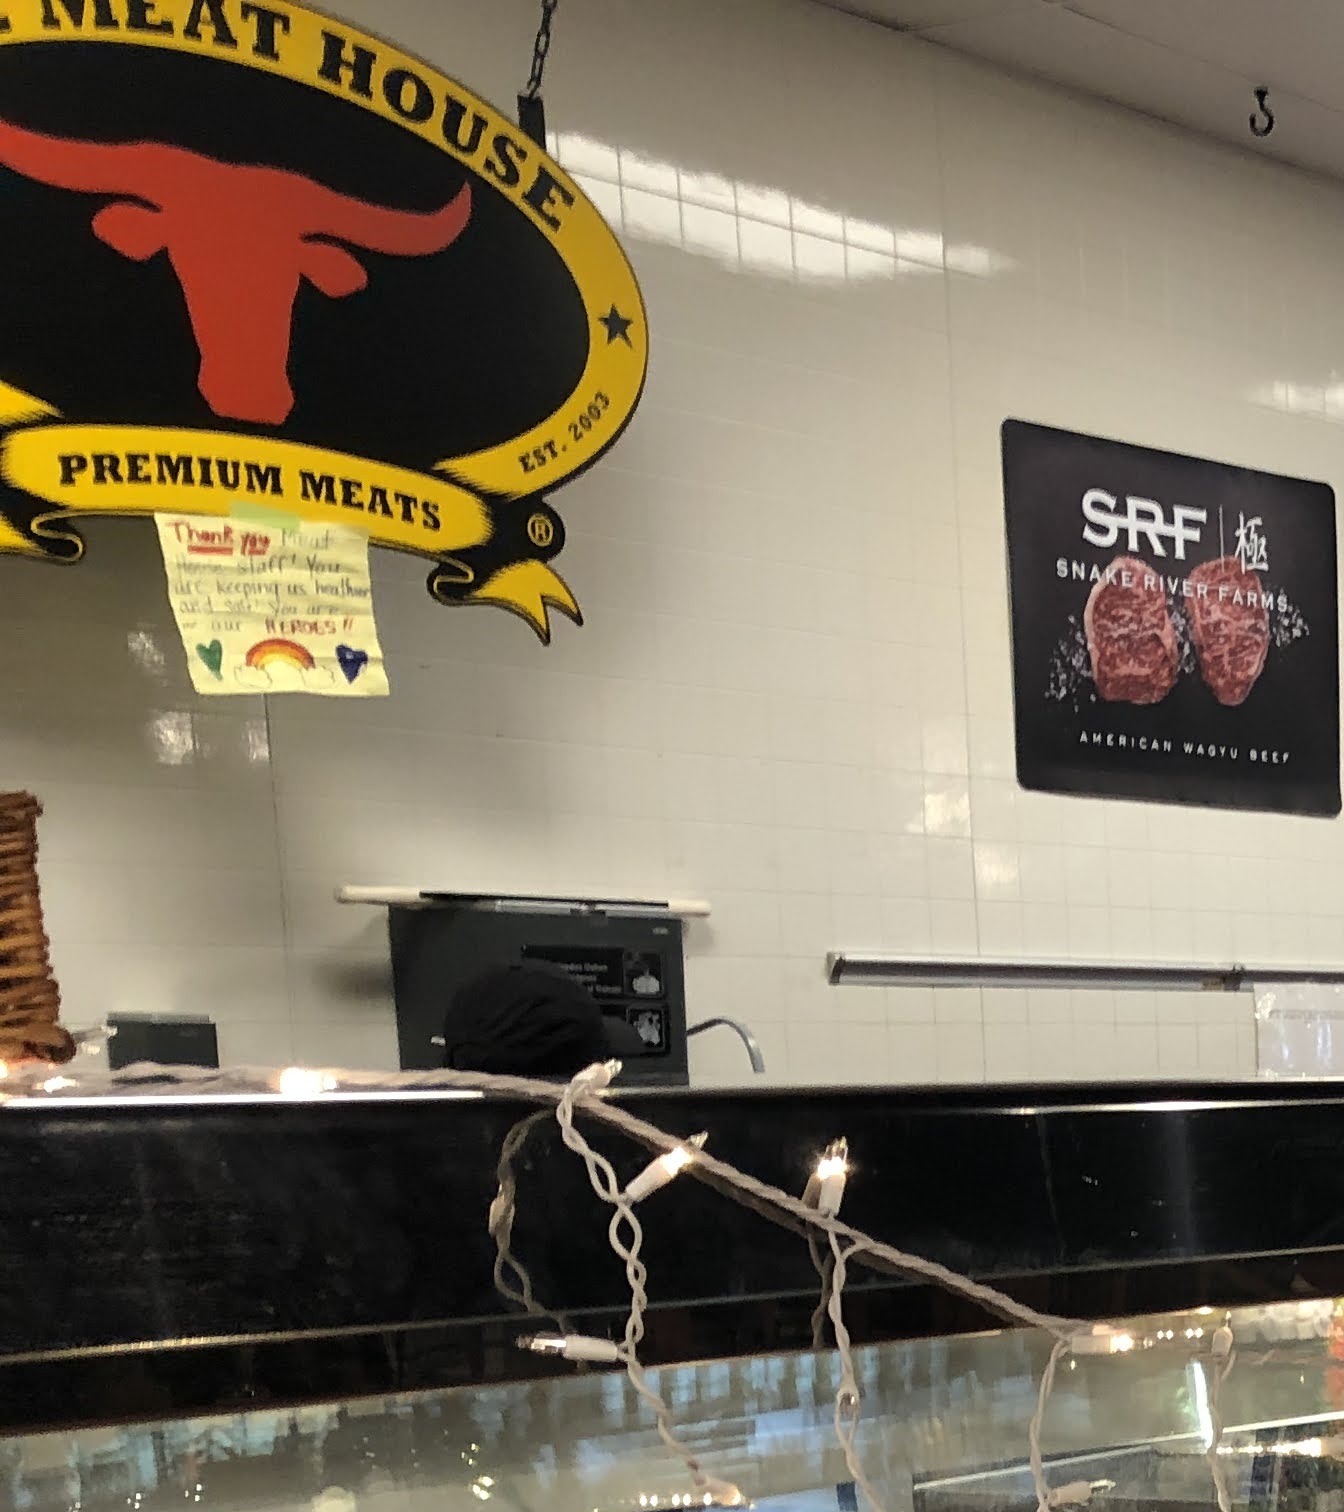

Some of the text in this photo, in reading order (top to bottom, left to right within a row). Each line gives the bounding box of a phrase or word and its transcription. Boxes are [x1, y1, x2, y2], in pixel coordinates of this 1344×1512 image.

[42, 0, 577, 232] MEAT HOUSE
[518, 392, 611, 475] EST. 2003
[58, 453, 442, 532] PREMIUM MEATS
[166, 519, 234, 545] Thank
[1081, 488, 1207, 560] SRF
[1234, 512, 1269, 574] 極
[216, 577, 280, 603] keeping
[287, 582, 307, 594] us
[1056, 557, 1288, 612] SNAKE RIVER FARMS
[1079, 730, 1290, 764] AMERICAN WAGYU BEEF
